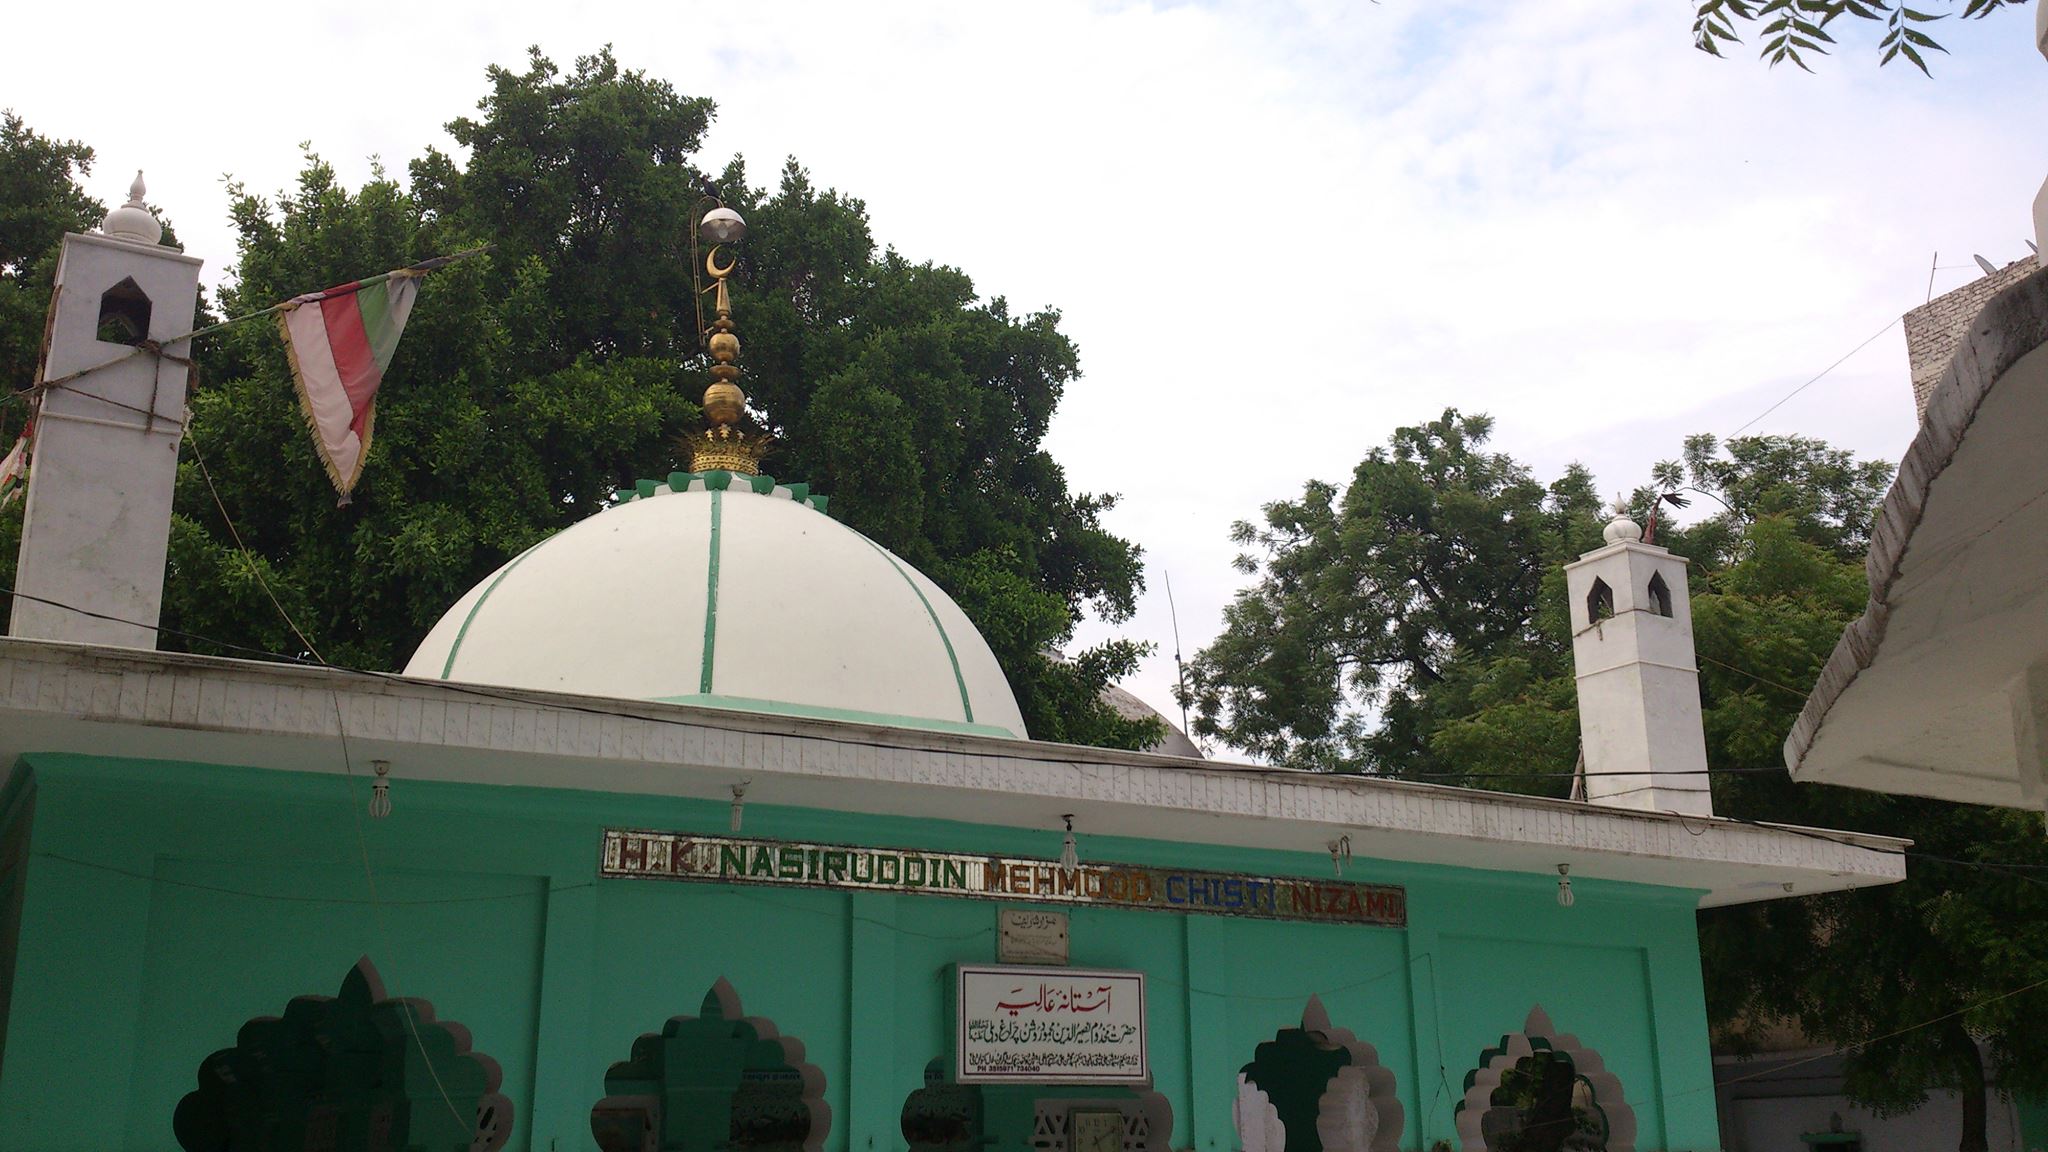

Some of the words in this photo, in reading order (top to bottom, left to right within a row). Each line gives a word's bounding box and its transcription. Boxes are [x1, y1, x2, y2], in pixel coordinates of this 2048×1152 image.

[720, 844, 966, 889] NASIRUDDIN
[984, 861, 1151, 903] MEHMOOD
[1165, 876, 1275, 911] CHISTI
[1291, 883, 1397, 919] NIZAMI
